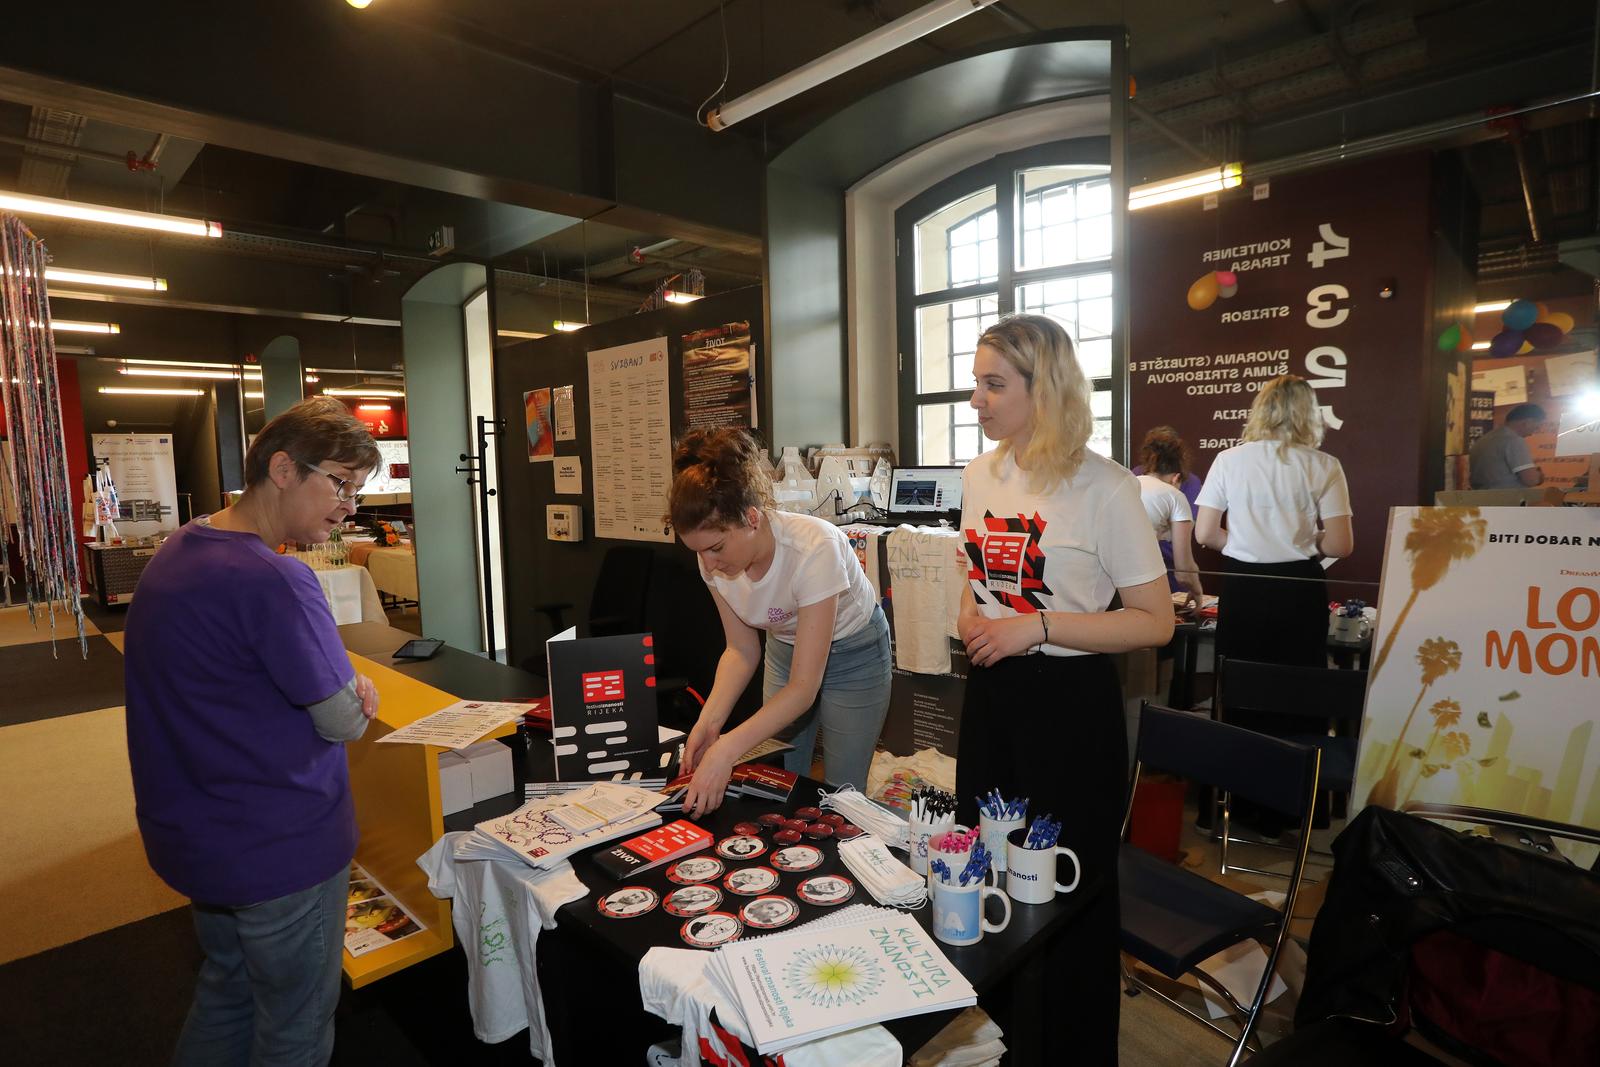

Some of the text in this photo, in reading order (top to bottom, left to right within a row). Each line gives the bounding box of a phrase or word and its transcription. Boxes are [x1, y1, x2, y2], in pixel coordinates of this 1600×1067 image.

[1489, 534, 1519, 544] BITI
[1524, 535, 1582, 546] DOBAR
[1526, 585, 1600, 631] LO
[587, 706, 625, 716] RIJEKA
[610, 847, 641, 866] ŽIVOT
[869, 927, 935, 998] ZNANOSTI
[894, 927, 951, 988] KULTURA
